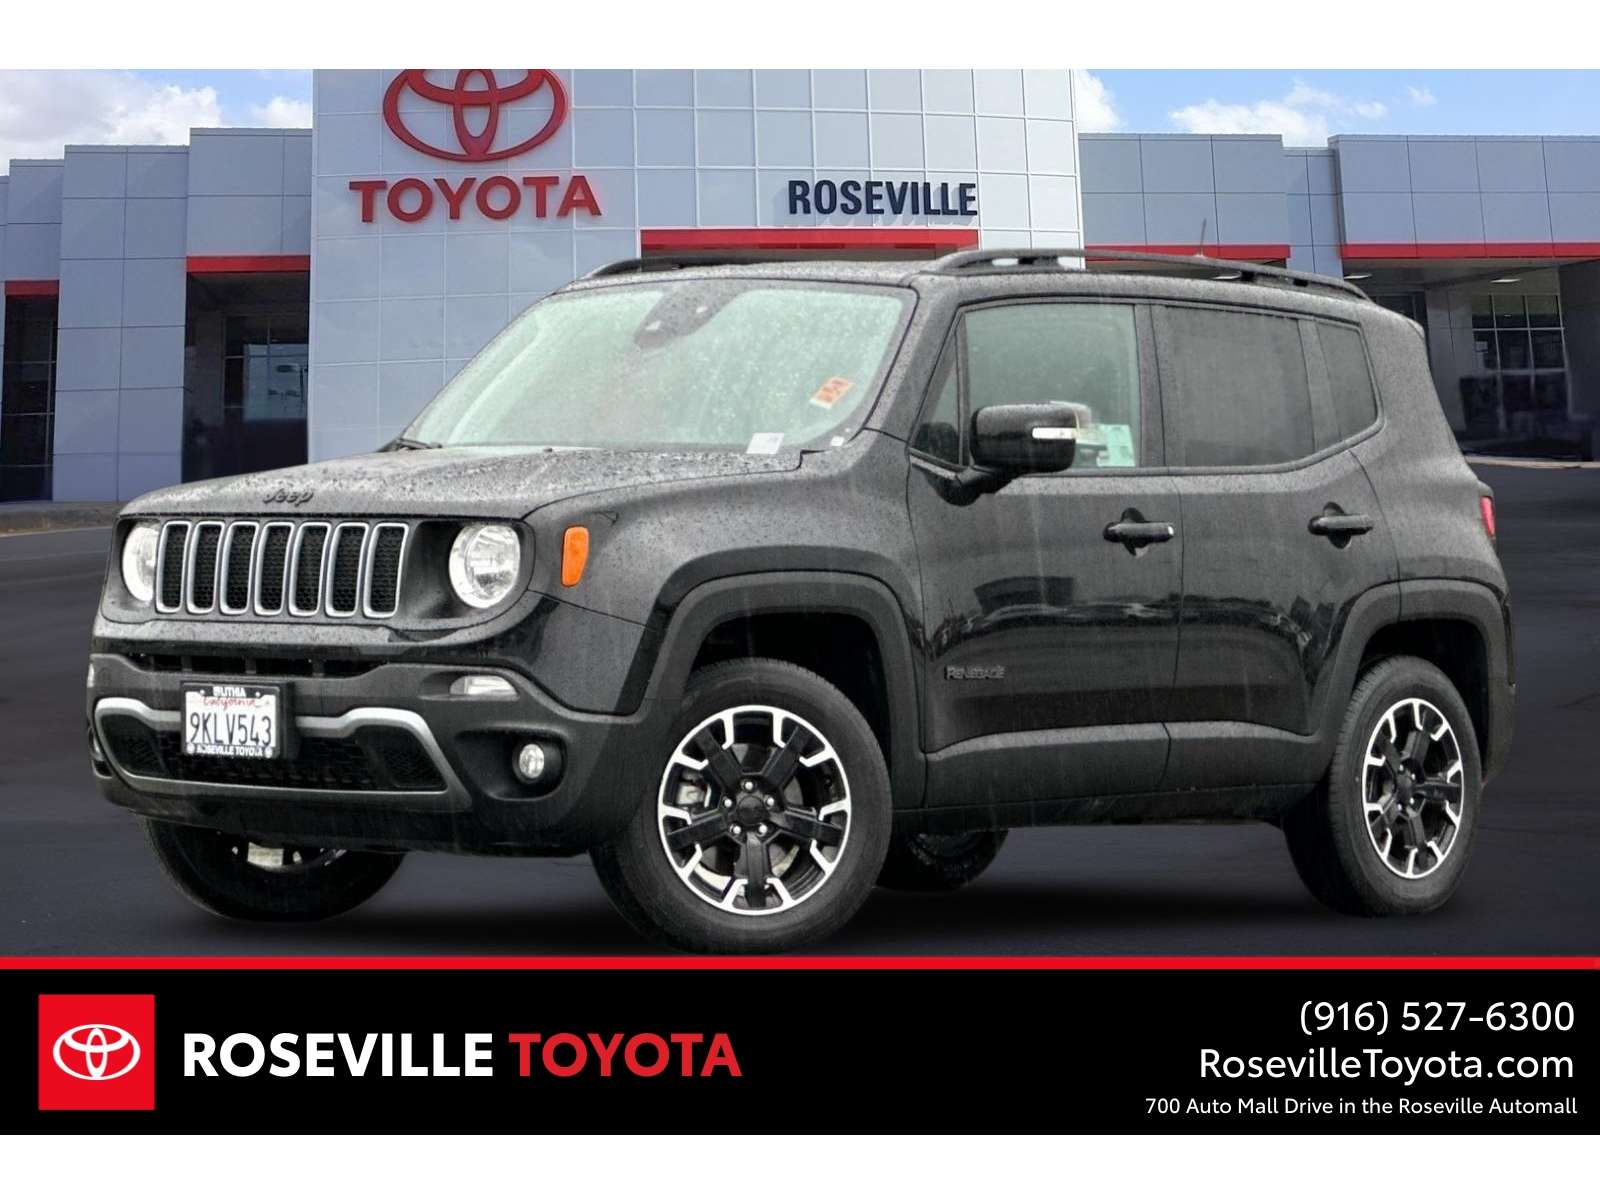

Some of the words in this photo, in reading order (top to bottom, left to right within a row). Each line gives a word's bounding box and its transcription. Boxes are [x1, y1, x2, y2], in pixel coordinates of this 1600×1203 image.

[349, 175, 602, 223] TOYOTA
[788, 179, 978, 216] ROSEVILLE
[263, 488, 314, 507] Jeep
[190, 712, 271, 747] 9KLV543
